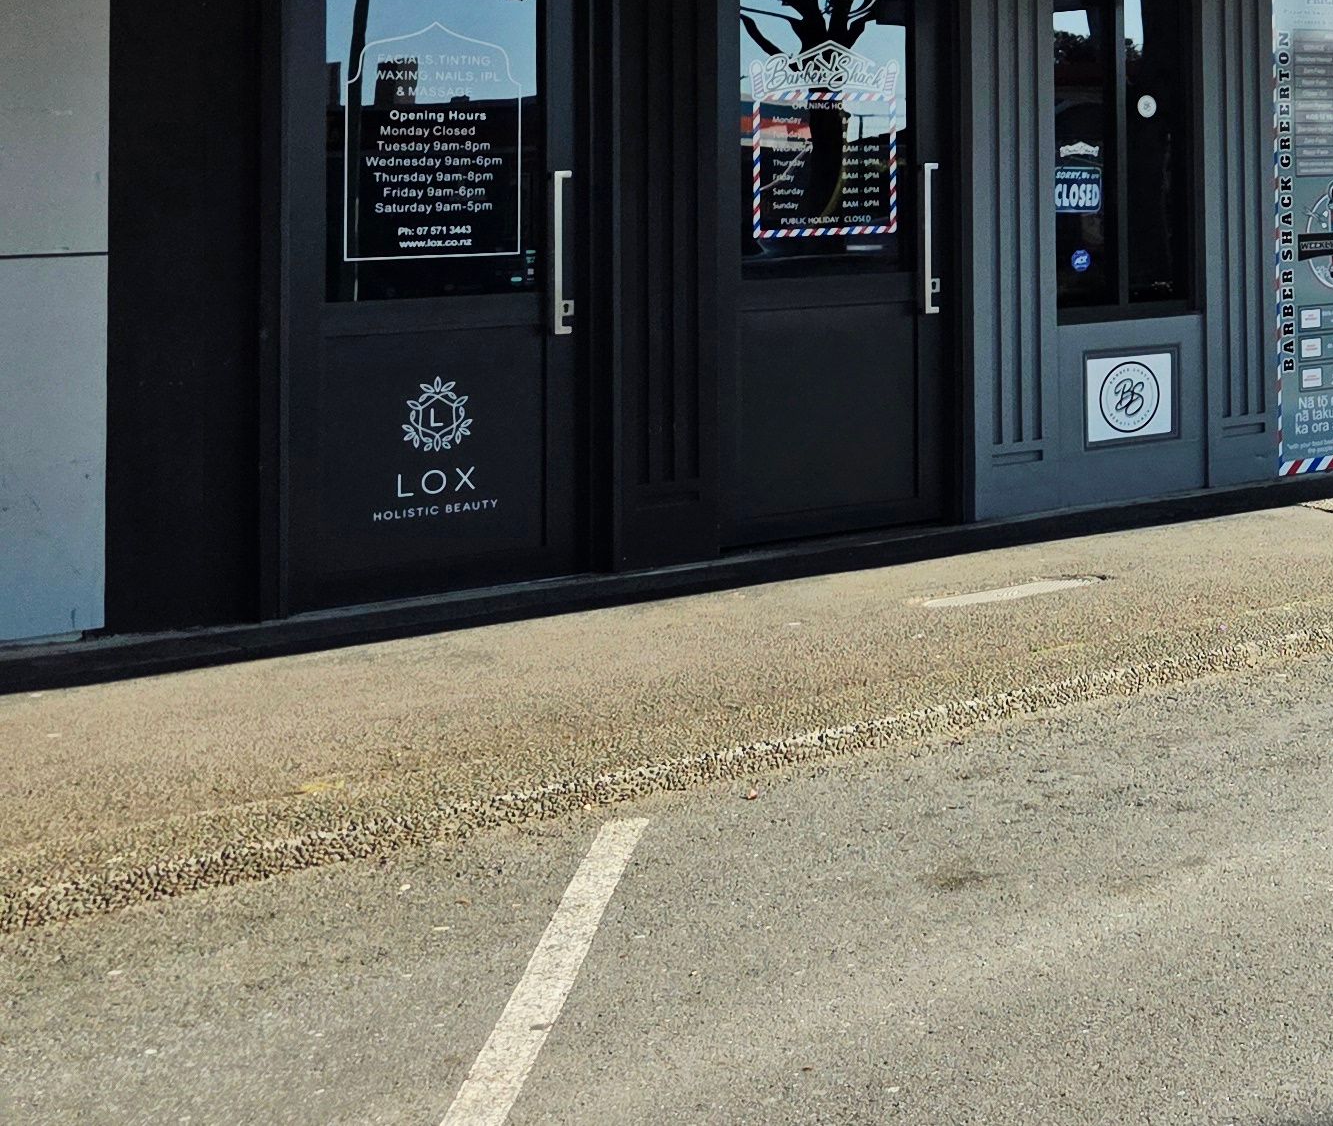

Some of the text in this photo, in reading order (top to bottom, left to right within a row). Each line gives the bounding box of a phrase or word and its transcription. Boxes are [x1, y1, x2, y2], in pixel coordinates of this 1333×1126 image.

[390, 110, 487, 123] Opening Hours
[380, 125, 476, 138] Monday Closed
[377, 140, 429, 153] Tuesday
[366, 156, 441, 168] Wednesday
[373, 172, 433, 184] Thursday
[383, 187, 423, 199] Friday
[1055, 183, 1100, 207] CLOSED
[1278, 31, 1294, 372] BARBER SHACK GREERTON
[375, 202, 432, 215] Saturday
[397, 466, 476, 498] LOX
[373, 498, 498, 521] HOLISTIC BEAUTY
